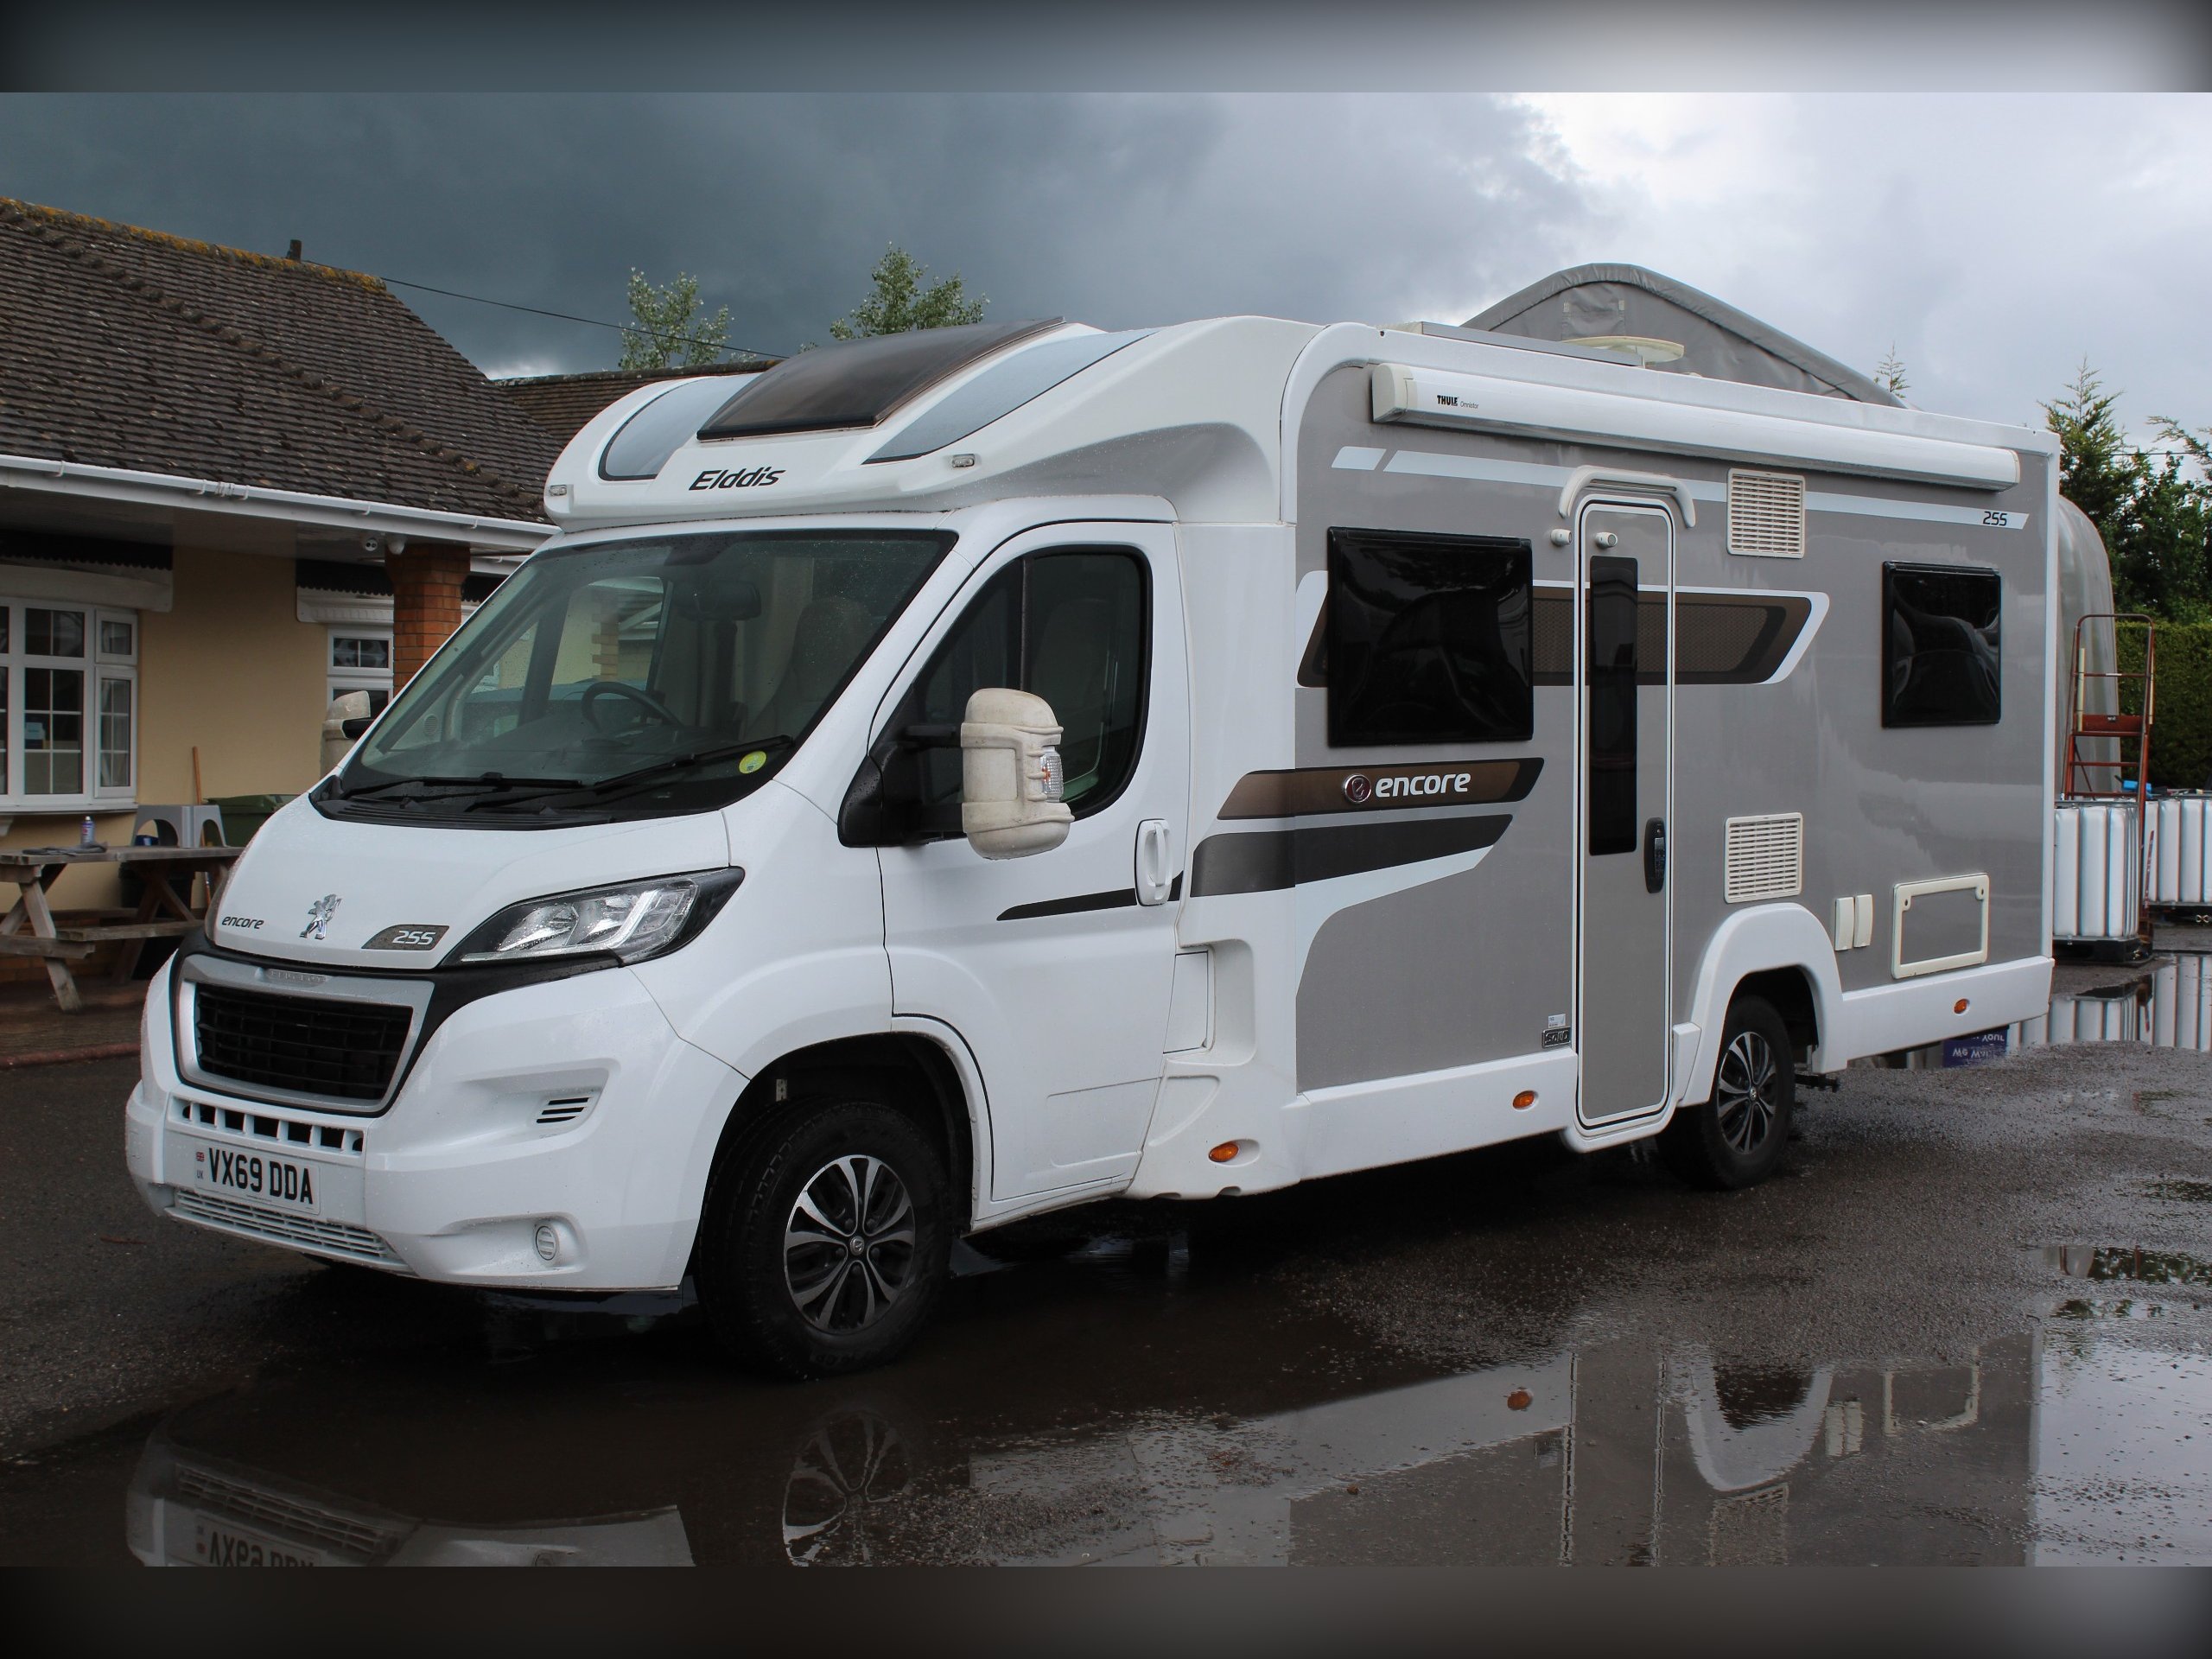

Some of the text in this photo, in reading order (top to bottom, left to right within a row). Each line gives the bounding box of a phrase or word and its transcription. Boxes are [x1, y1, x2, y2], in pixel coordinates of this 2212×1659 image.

[1437, 395, 1479, 410] THULE Omnistor
[689, 466, 786, 491] Elddis
[1983, 511, 2007, 526] 255
[1376, 773, 1471, 798] encore
[221, 915, 264, 930] encore
[392, 930, 435, 945] 255
[196, 1170, 204, 1180] UK
[209, 1147, 313, 1205] VX69 DDA
